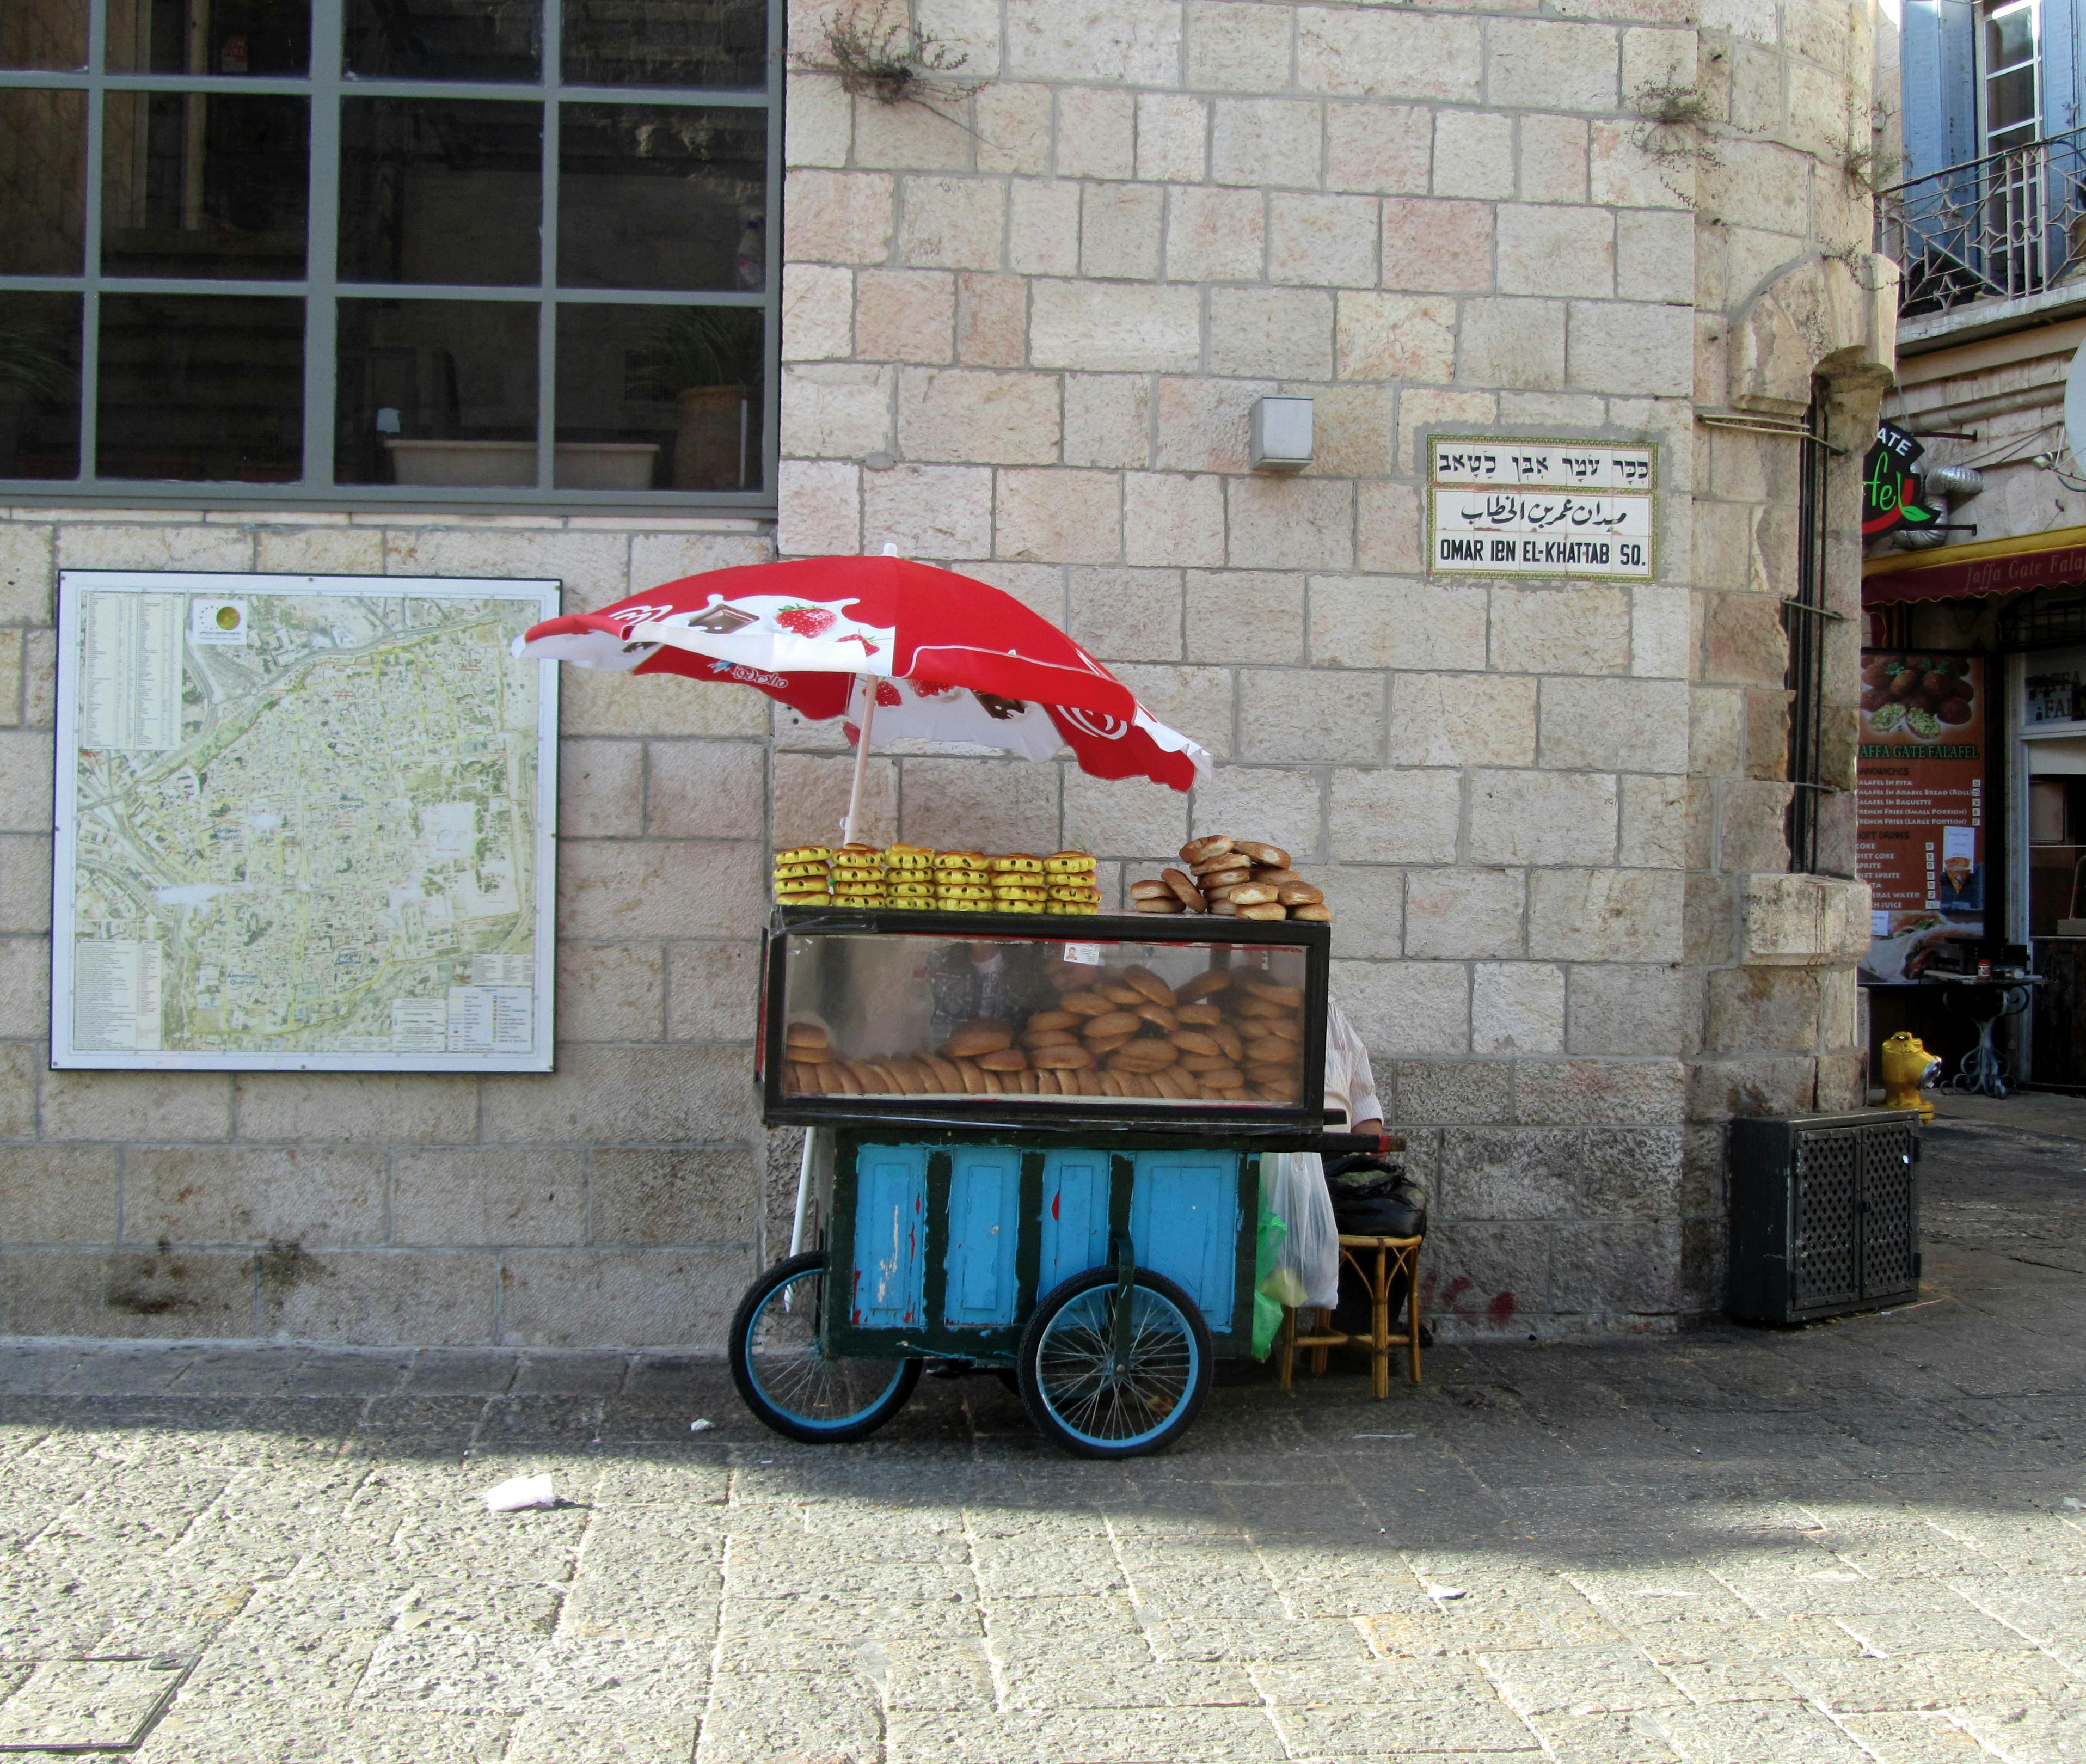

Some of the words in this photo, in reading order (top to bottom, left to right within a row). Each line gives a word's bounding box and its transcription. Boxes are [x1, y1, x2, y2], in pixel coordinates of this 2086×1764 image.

[1877, 428, 1912, 456] ATE
[1863, 451, 1917, 518] fel
[1461, 494, 1525, 525] الخطاب
[1527, 503, 1554, 528] بن
[1544, 498, 1574, 526] عمر
[1572, 500, 1627, 532] ميدان
[1440, 539, 1484, 561] OMAR
[1490, 540, 1516, 562] IBN
[1523, 541, 1610, 565] EL-KHATTAB
[1620, 544, 1646, 567] SQ.
[1964, 562, 2001, 592] Jaffa
[2008, 560, 2042, 579] Gate
[1860, 745, 1891, 758] AFFA
[1893, 745, 1927, 758] GATE
[1928, 745, 1979, 758] FALAFEL
[1859, 767, 1909, 775] ANDWICHES
[1879, 831, 1910, 840] DRINKS
